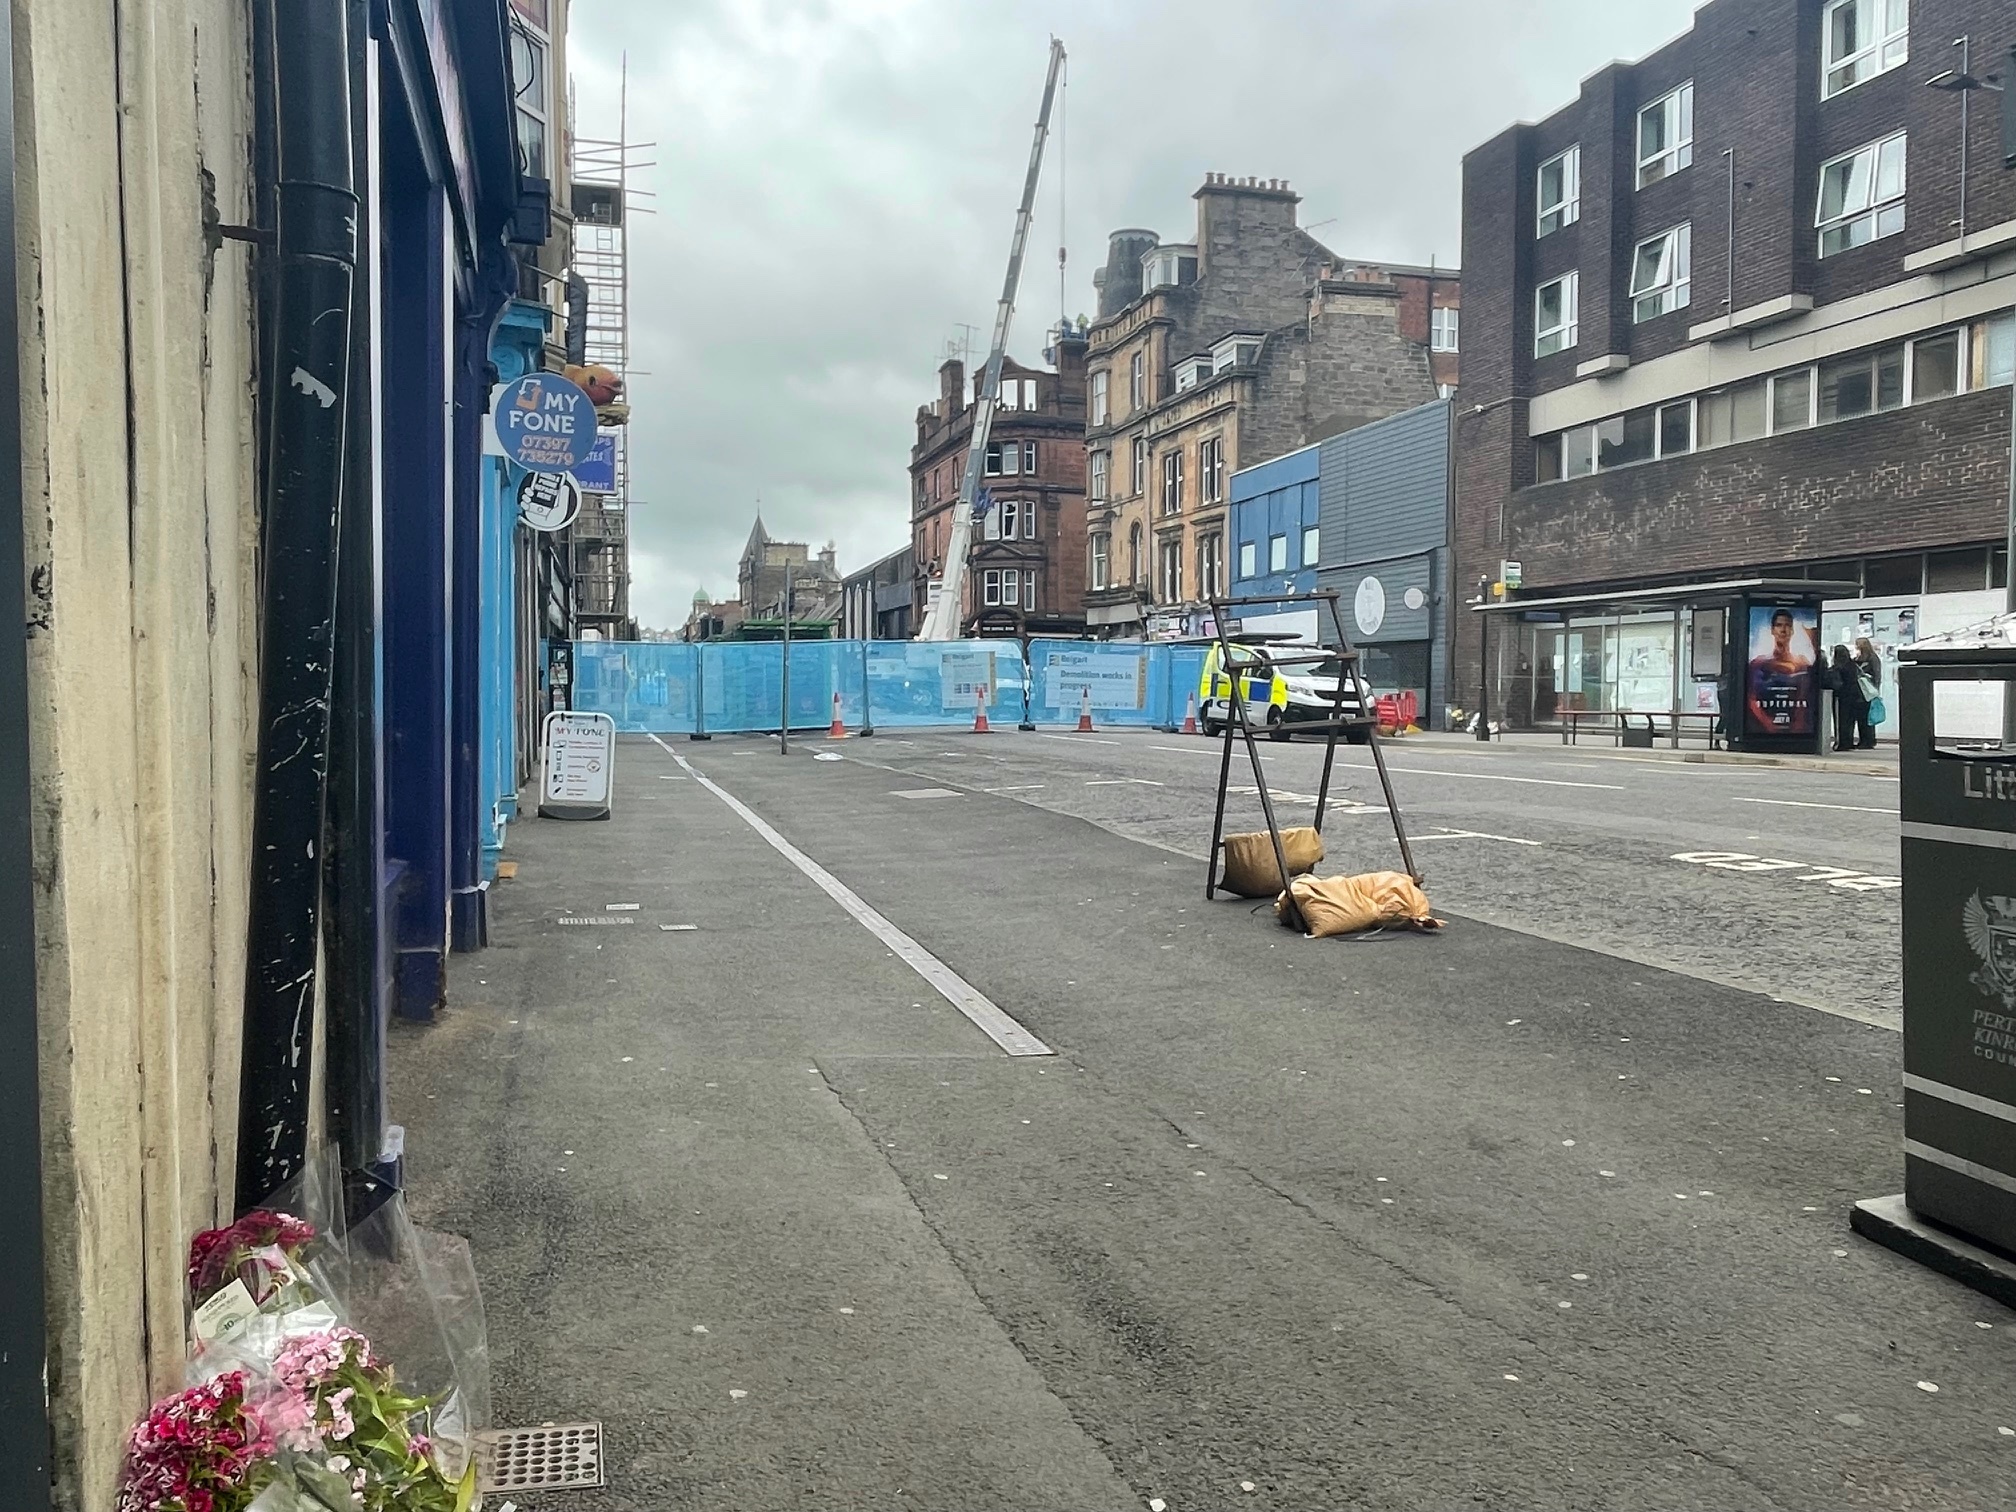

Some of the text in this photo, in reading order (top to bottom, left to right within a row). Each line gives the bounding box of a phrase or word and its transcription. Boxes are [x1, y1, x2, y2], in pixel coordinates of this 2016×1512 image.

[544, 392, 580, 412] MY
[508, 410, 575, 434] FONE
[1060, 670, 1100, 679] Demolition
[1102, 672, 1124, 680] works
